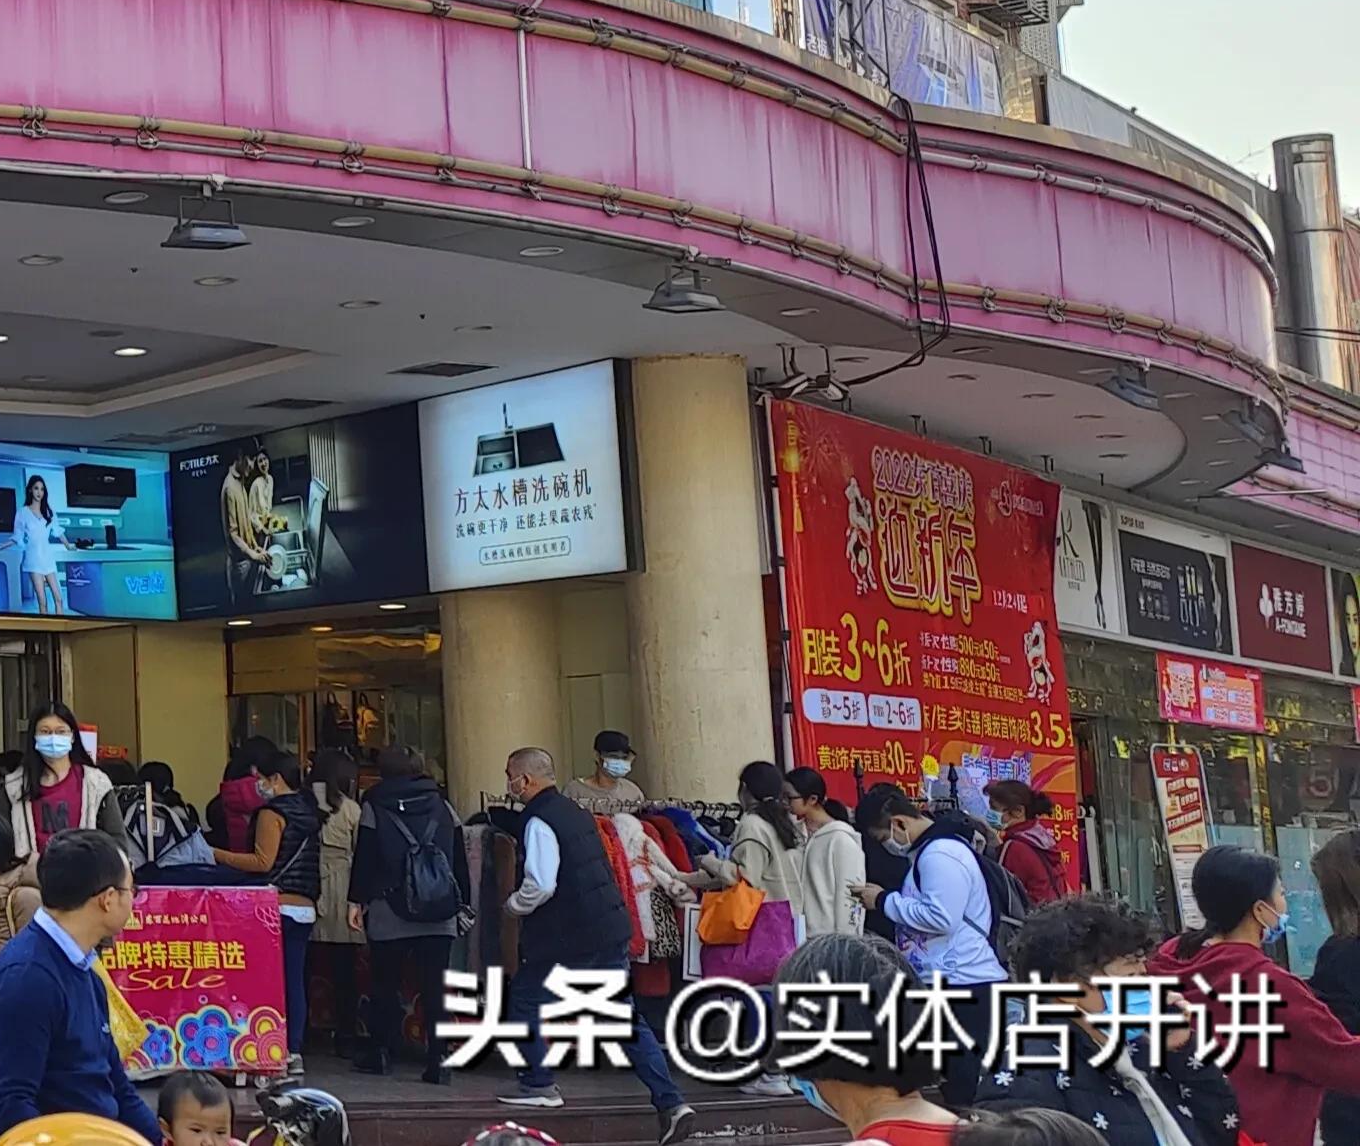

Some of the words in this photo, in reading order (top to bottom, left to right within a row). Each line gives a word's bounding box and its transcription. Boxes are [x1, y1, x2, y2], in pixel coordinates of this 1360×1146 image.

[454, 467, 593, 517] 方太水槽洗碗机
[118, 966, 227, 992] Sale
